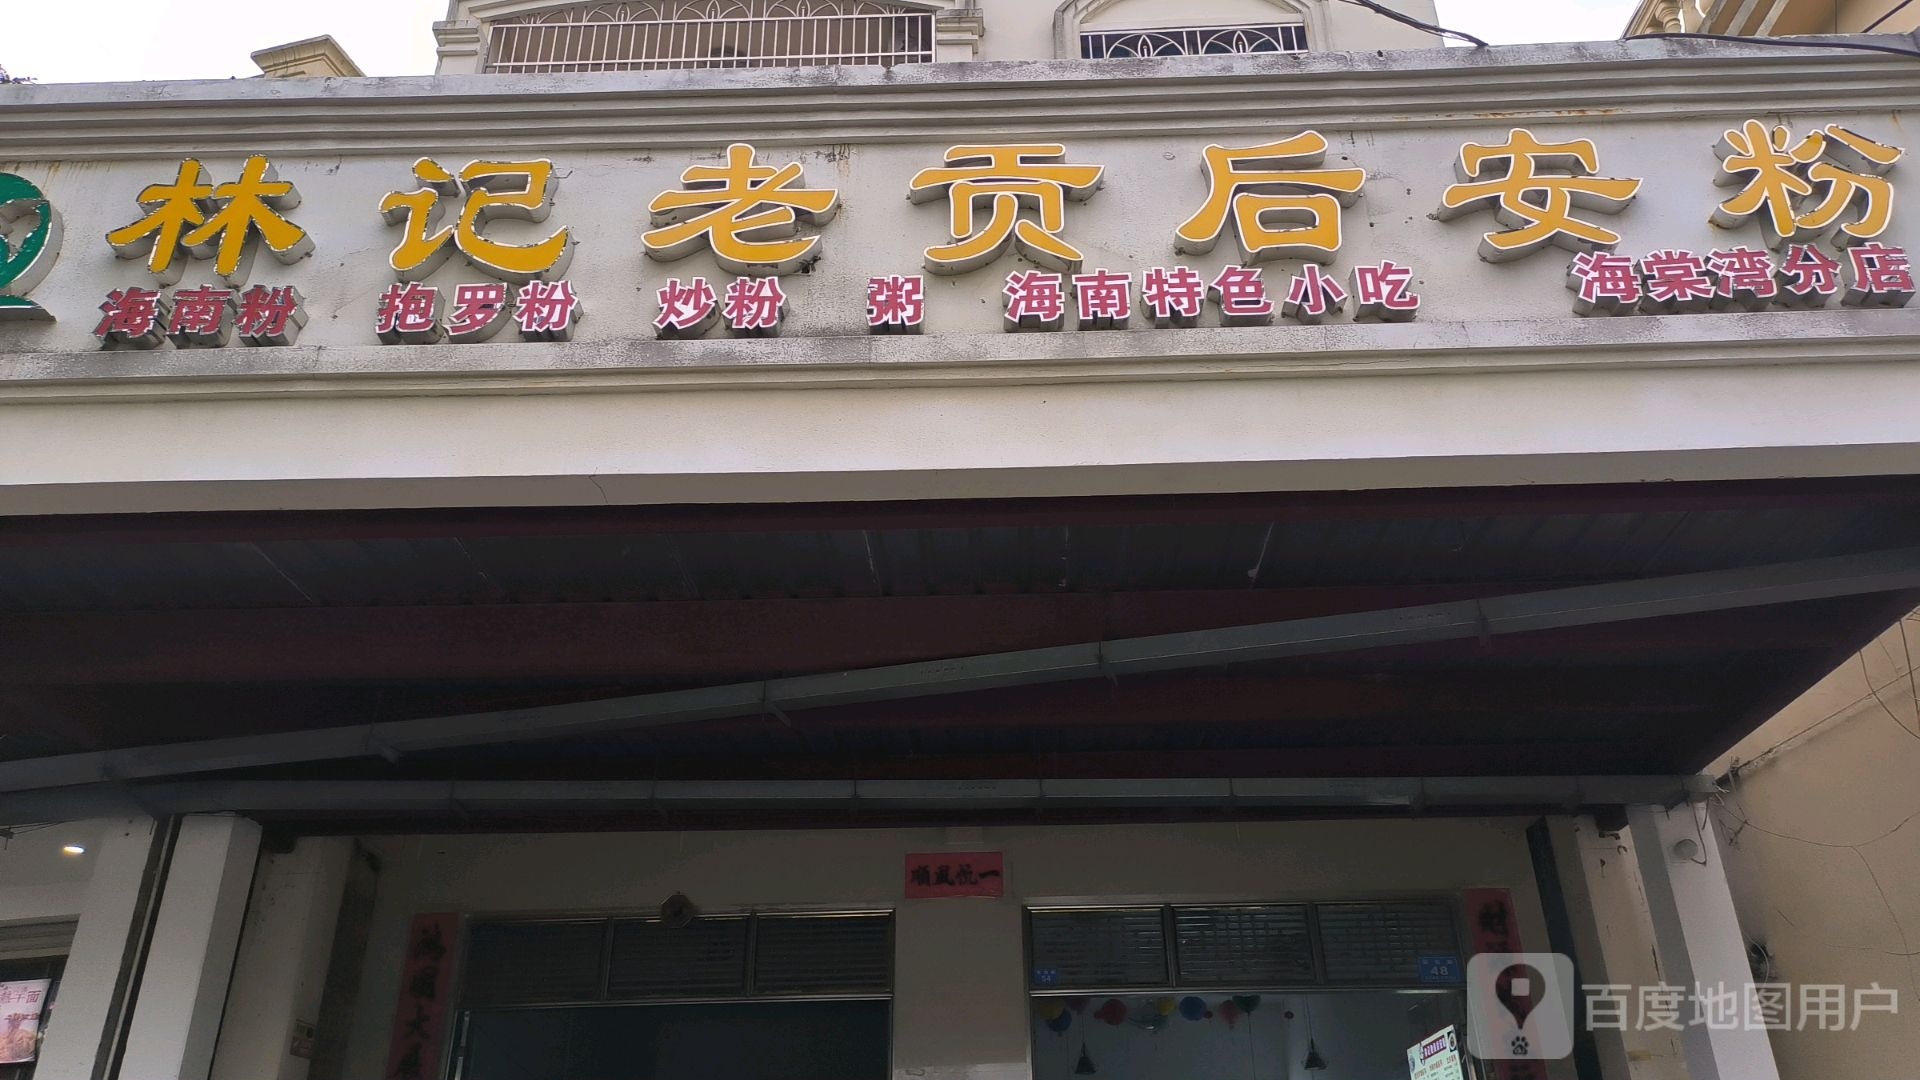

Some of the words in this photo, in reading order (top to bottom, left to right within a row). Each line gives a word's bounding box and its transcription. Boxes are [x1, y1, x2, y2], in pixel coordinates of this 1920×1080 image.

[105, 119, 1905, 276] 林记老贡后安粉
[96, 283, 302, 338] 海南粉
[377, 280, 577, 334] 抱罗粉
[655, 276, 786, 330] 炒粉
[867, 275, 924, 326] 粥
[1003, 258, 1421, 321] 海南特色小吃
[1570, 241, 1914, 304] 海棠湾分店
[1430, 966, 1449, 976] 48
